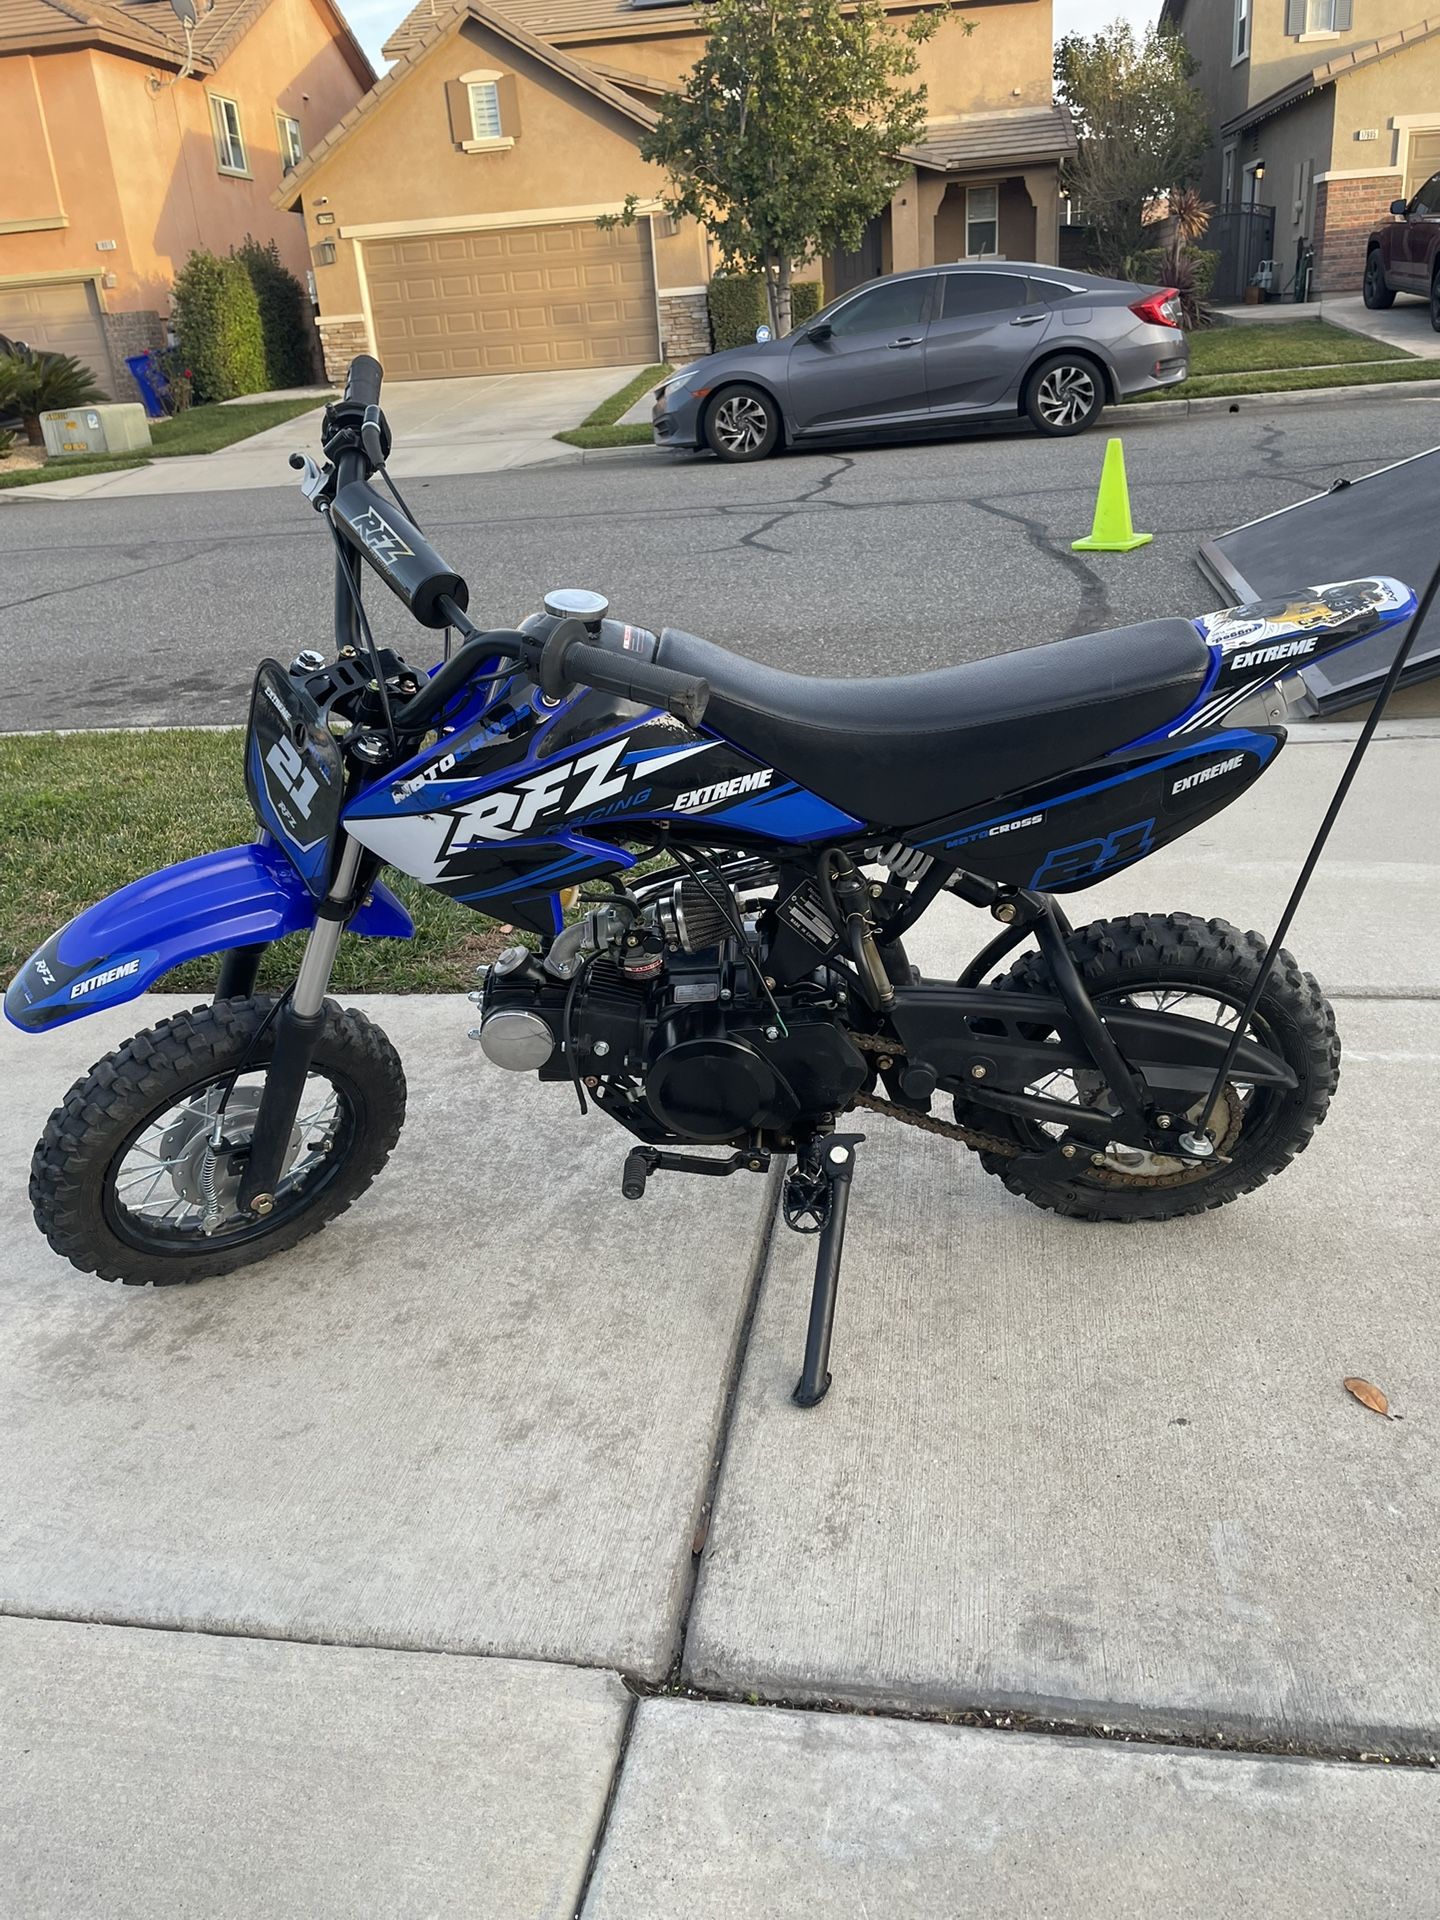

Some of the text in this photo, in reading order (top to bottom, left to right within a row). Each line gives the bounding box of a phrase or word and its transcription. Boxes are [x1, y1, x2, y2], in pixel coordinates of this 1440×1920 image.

[350, 506, 416, 566] RFZ
[1230, 637, 1319, 671] EXTREME
[264, 686, 292, 722] EXTREME
[266, 734, 320, 821] 21
[673, 768, 774, 812] EXTREME
[1171, 753, 1245, 796] EXTREME
[277, 801, 298, 829] RFZ
[451, 736, 631, 855] RFZ
[945, 814, 1043, 849] MOTOCROSS
[35, 959, 56, 985] RFZ
[70, 959, 140, 999] EXTREME
